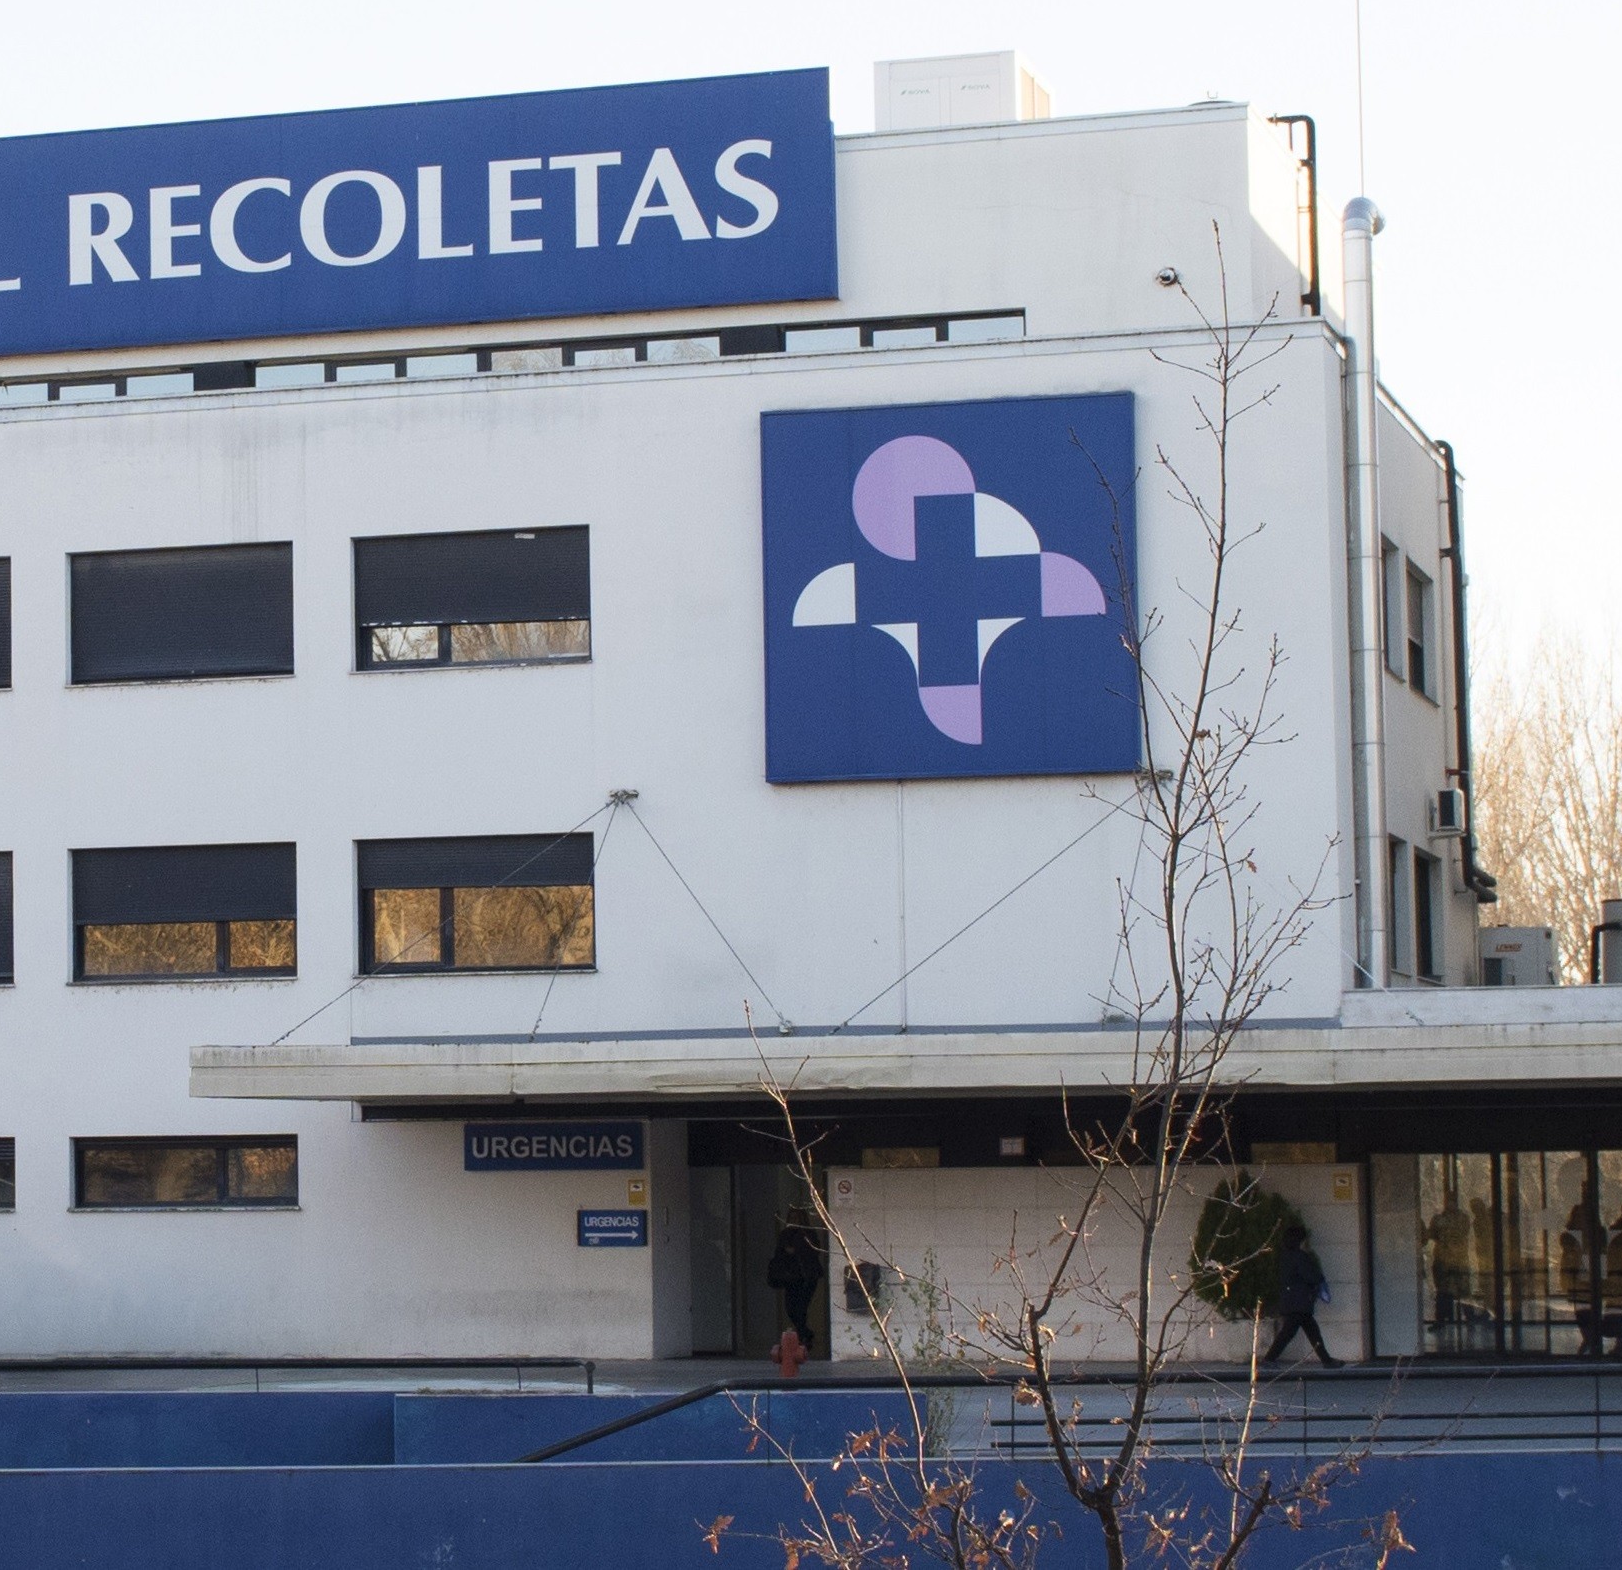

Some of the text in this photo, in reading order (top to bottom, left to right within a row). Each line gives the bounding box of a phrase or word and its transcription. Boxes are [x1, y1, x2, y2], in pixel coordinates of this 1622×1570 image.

[67, 138, 780, 286] RECOLETAS
[471, 1134, 634, 1159] URGENCIAS
[584, 1216, 639, 1227] URGENCIAS
